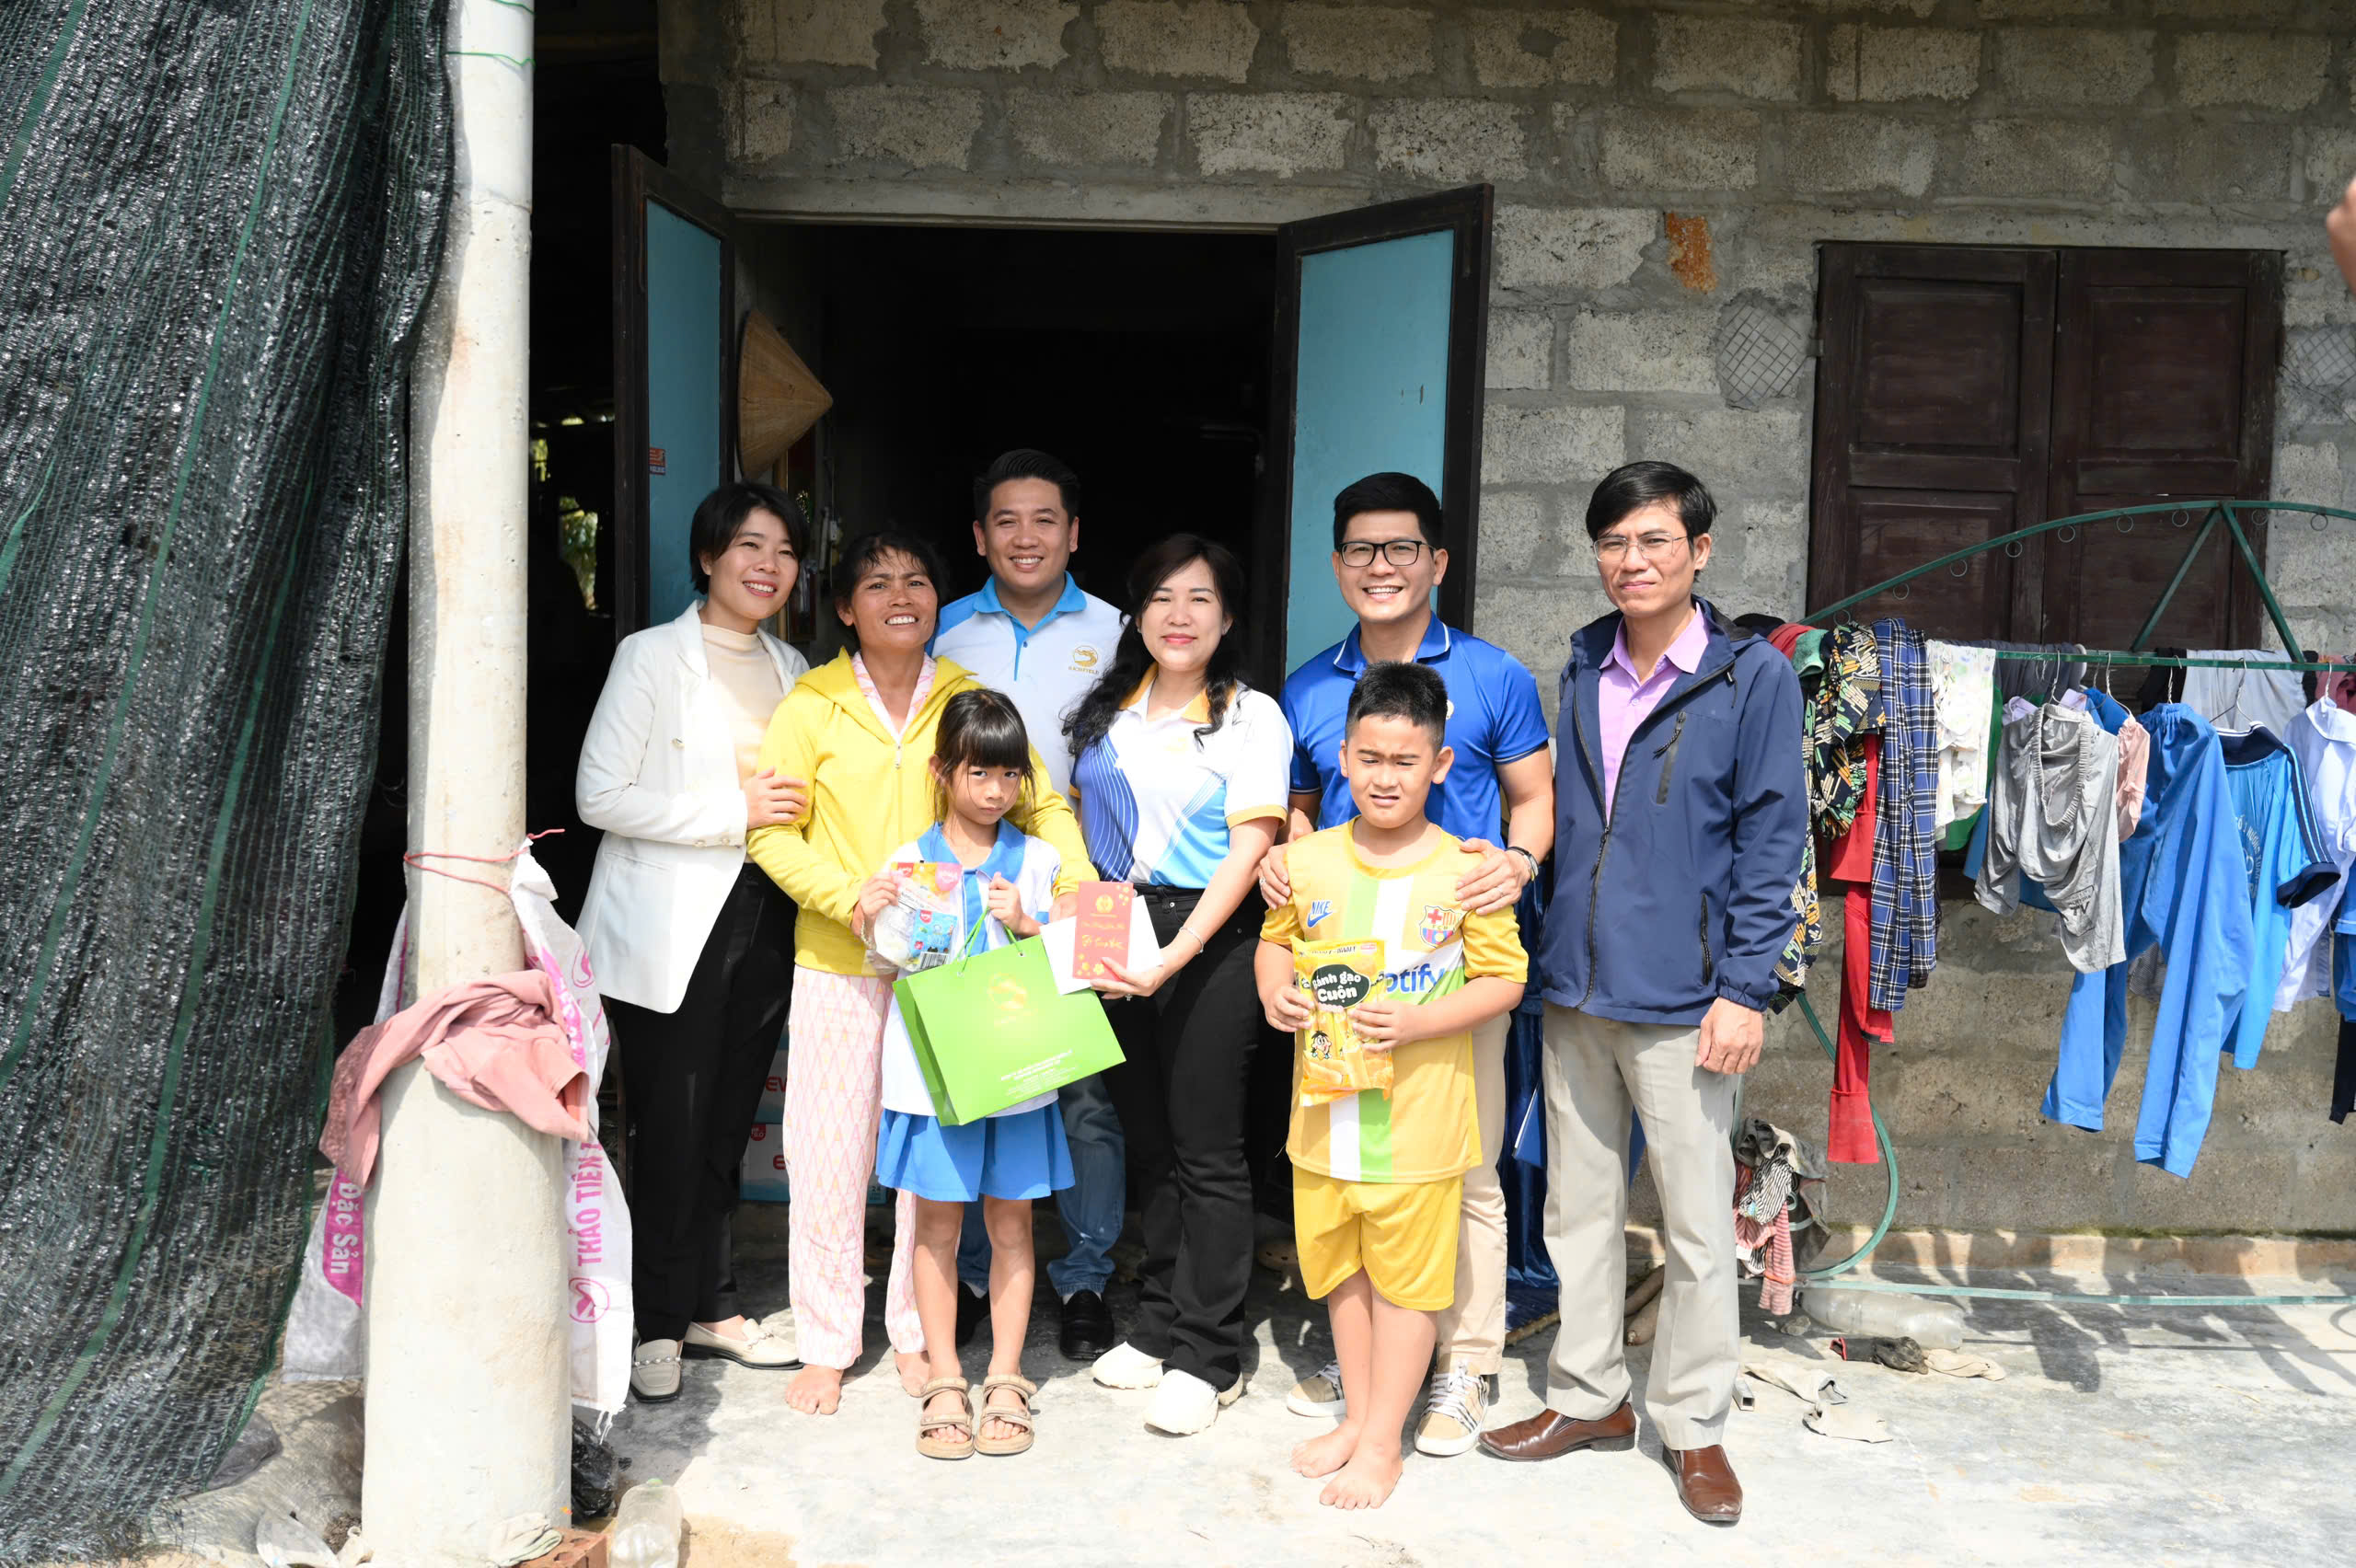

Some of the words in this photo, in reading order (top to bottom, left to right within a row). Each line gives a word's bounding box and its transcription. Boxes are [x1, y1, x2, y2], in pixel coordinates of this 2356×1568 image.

[1311, 901, 1331, 915] NIKE
[1312, 973, 1337, 989] Bánh
[1339, 971, 1361, 986] gạo
[1317, 985, 1357, 1003] Cuộn
[1384, 963, 1446, 994] otify
[571, 1155, 604, 1204] TIÊN
[330, 1182, 362, 1226] Đặc
[329, 1232, 360, 1274] Sản
[567, 1207, 603, 1267] THẢO
